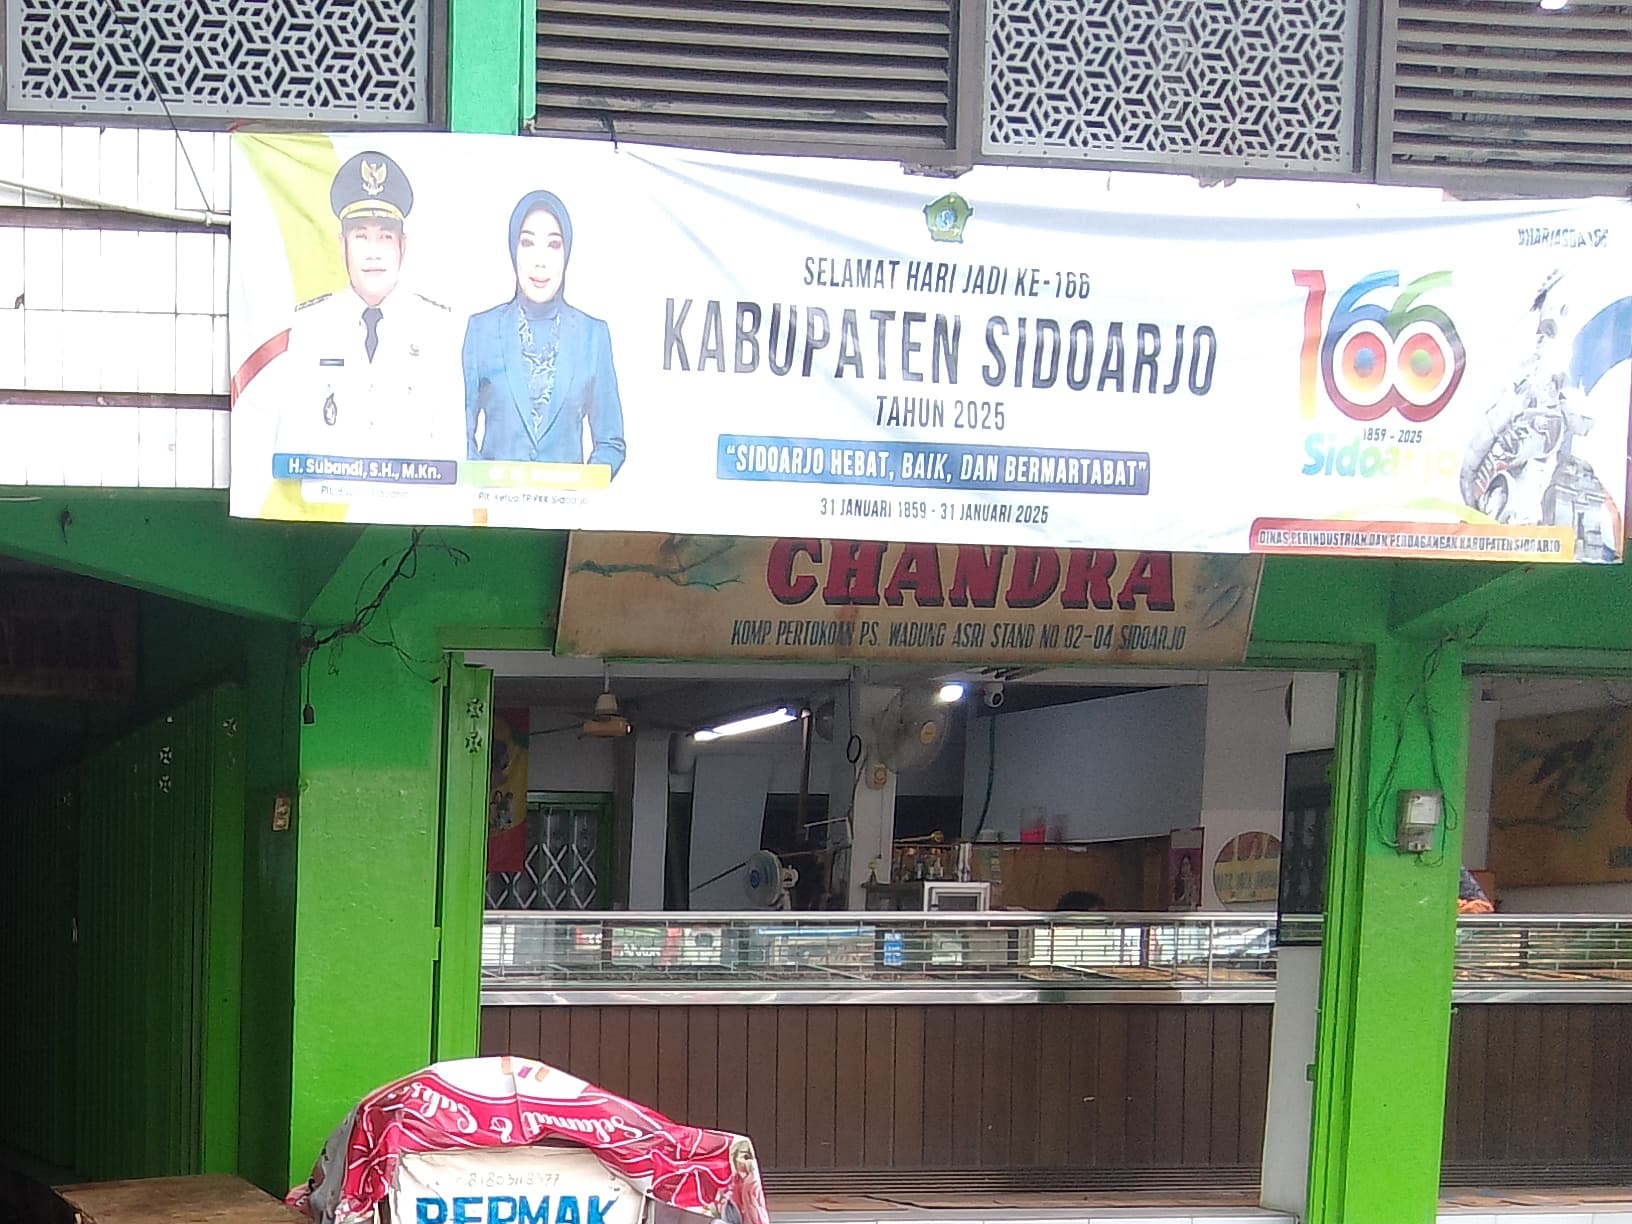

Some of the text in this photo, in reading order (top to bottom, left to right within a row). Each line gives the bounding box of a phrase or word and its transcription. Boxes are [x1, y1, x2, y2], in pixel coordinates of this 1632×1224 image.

[803, 256, 1090, 299] SELAMAT HARI JADI KE-166
[663, 298, 1216, 396] KABUPATEN SIDOARJO
[1292, 270, 1466, 423] 166
[876, 395, 1005, 430] TAHUN 2025
[1362, 428, 1386, 441] 1859
[1398, 430, 1423, 443] 2025
[289, 458, 303, 474] H.
[306, 458, 367, 479] Subandi,
[402, 463, 442, 480] M.Kn.
[726, 443, 1147, 486] “SIDOARJO HEBAT, BAIK, DAN BERMARTABAT”
[820, 498, 836, 516] 31
[839, 498, 892, 518] JANUARI
[898, 500, 927, 519] 1859
[940, 502, 956, 520] 31
[959, 503, 1012, 522] JANUARI
[1015, 504, 1049, 524] 2025
[1260, 531, 1288, 544] DINAS
[767, 537, 1176, 611] CHANDRA
[731, 619, 1186, 651] KOMP PERTOKOAN PS. WADUNG ASRI STAND NO 02-04 SIDOARJO
[520, 1111, 644, 1143] Selamat
